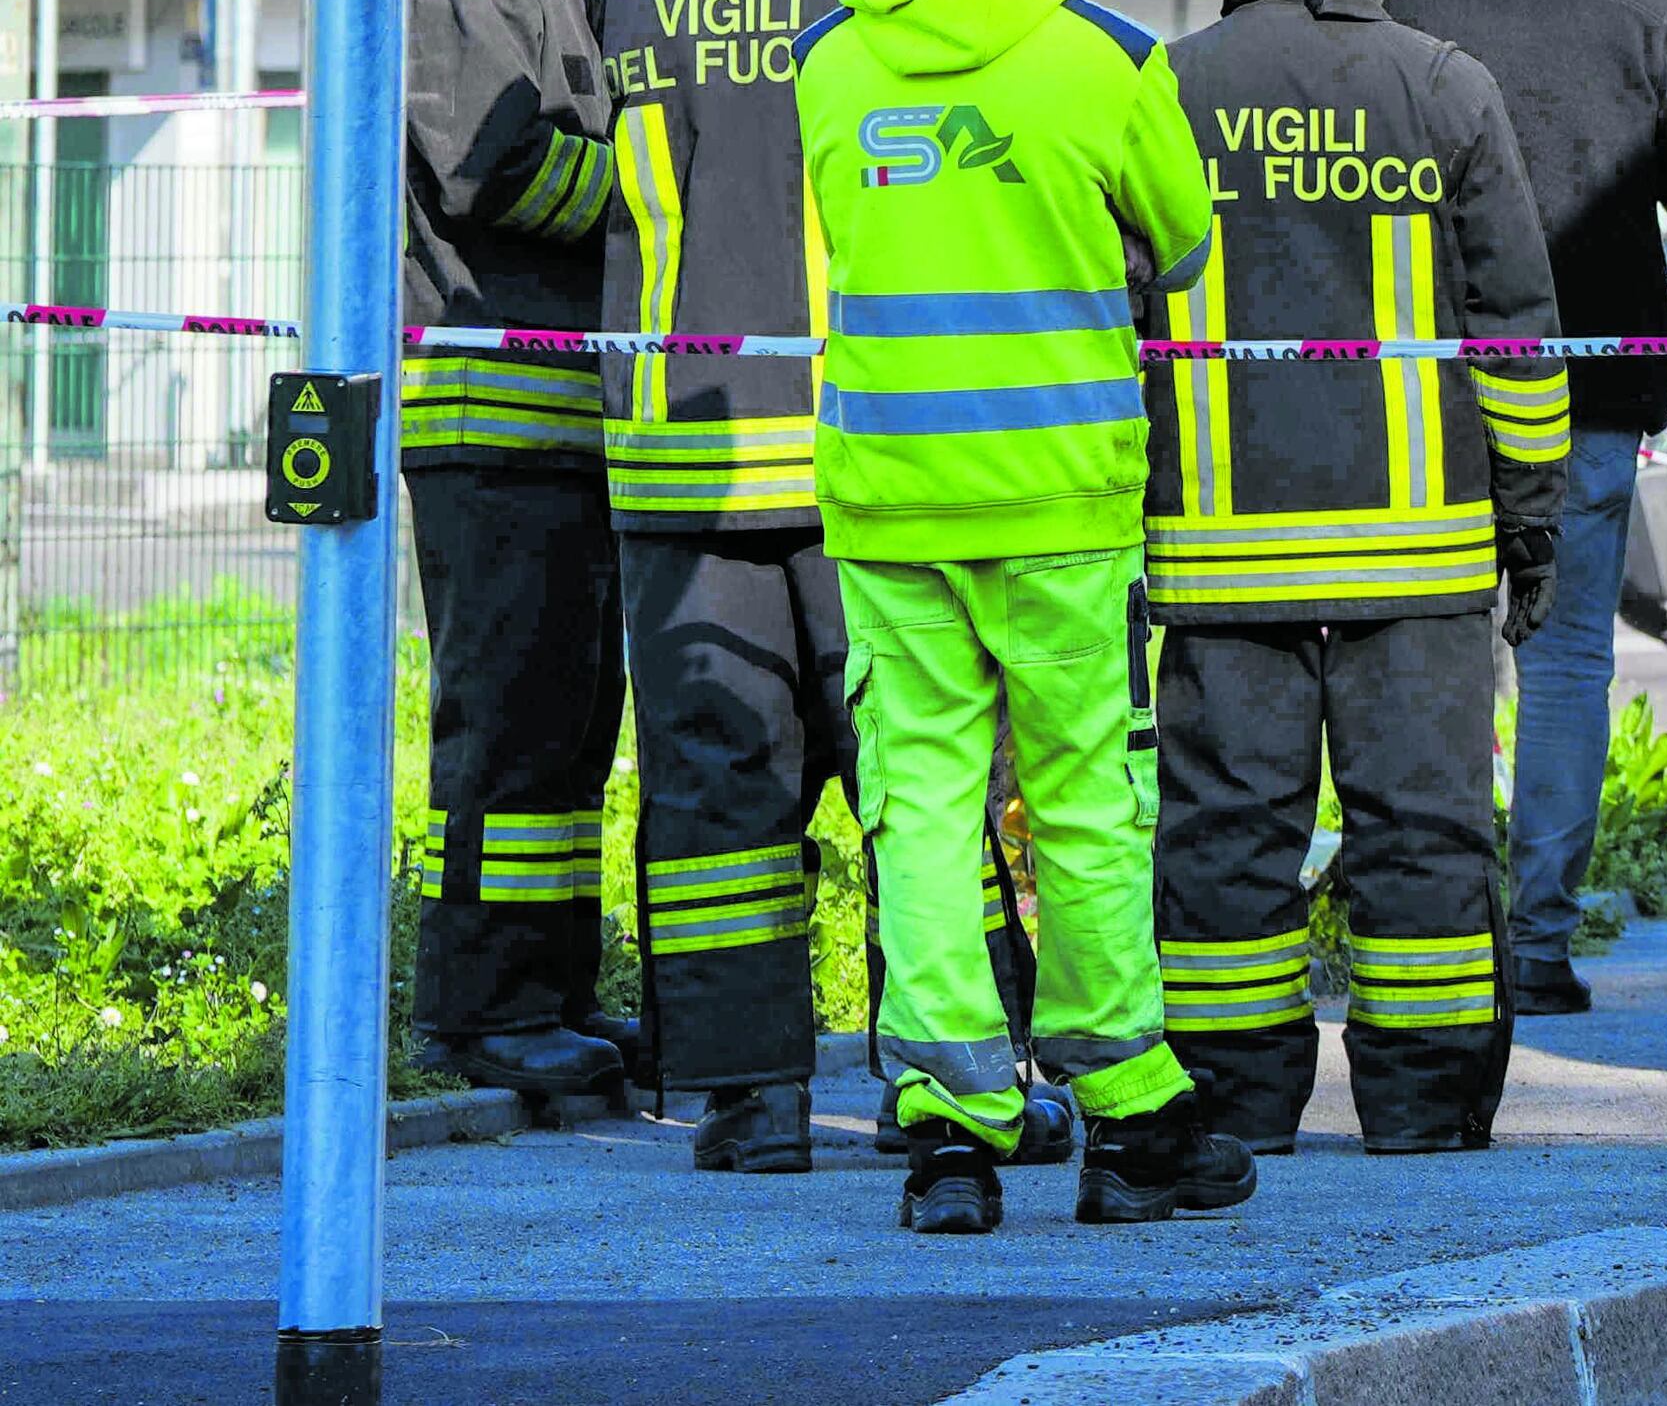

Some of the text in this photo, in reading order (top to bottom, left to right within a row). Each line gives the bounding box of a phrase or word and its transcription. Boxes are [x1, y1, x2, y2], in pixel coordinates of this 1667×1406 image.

[602, 45, 676, 98] DEL
[1215, 107, 1366, 153] VIGILI
[1264, 155, 1443, 203] FUOCO
